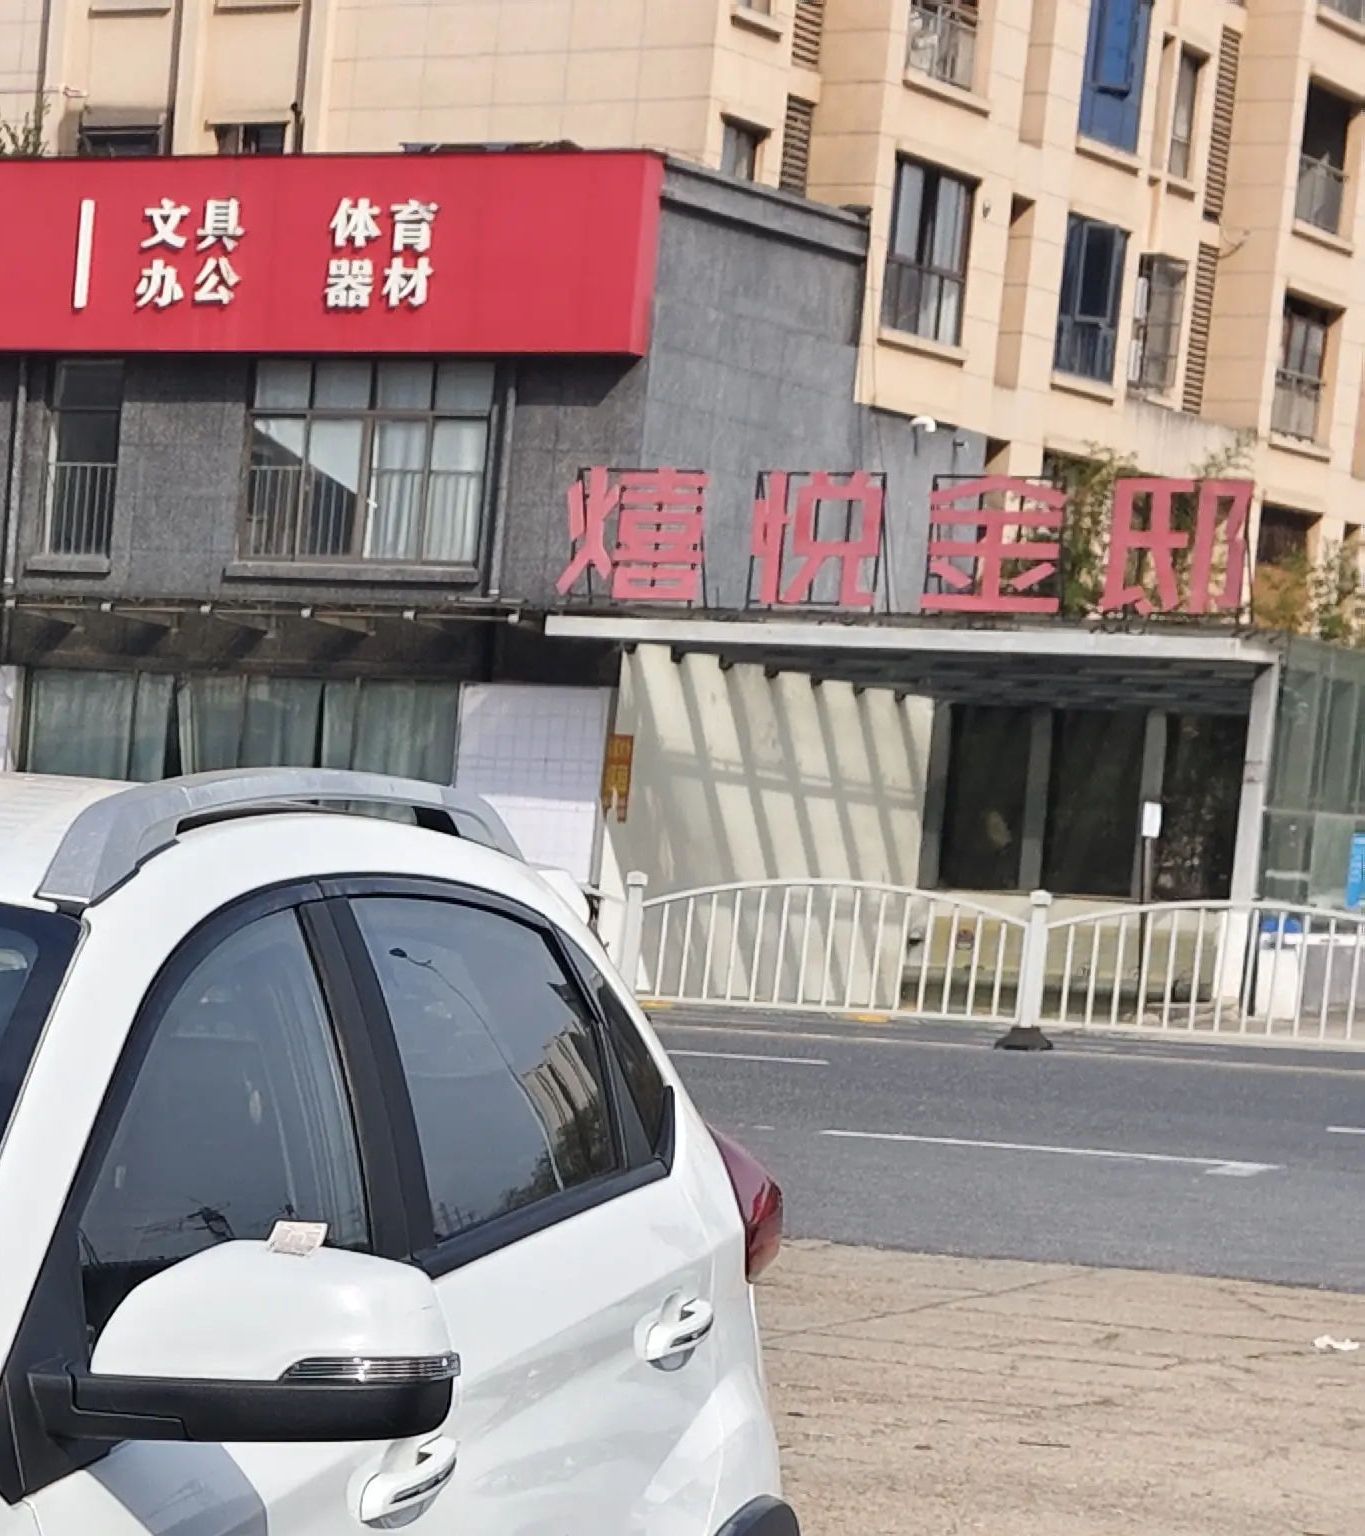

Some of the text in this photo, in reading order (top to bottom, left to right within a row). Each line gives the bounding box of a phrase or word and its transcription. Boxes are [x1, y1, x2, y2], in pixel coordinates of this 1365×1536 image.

[140, 197, 245, 251] 文具
[329, 197, 439, 253] 体育
[134, 257, 243, 309] 办公
[324, 257, 435, 309] 器材
